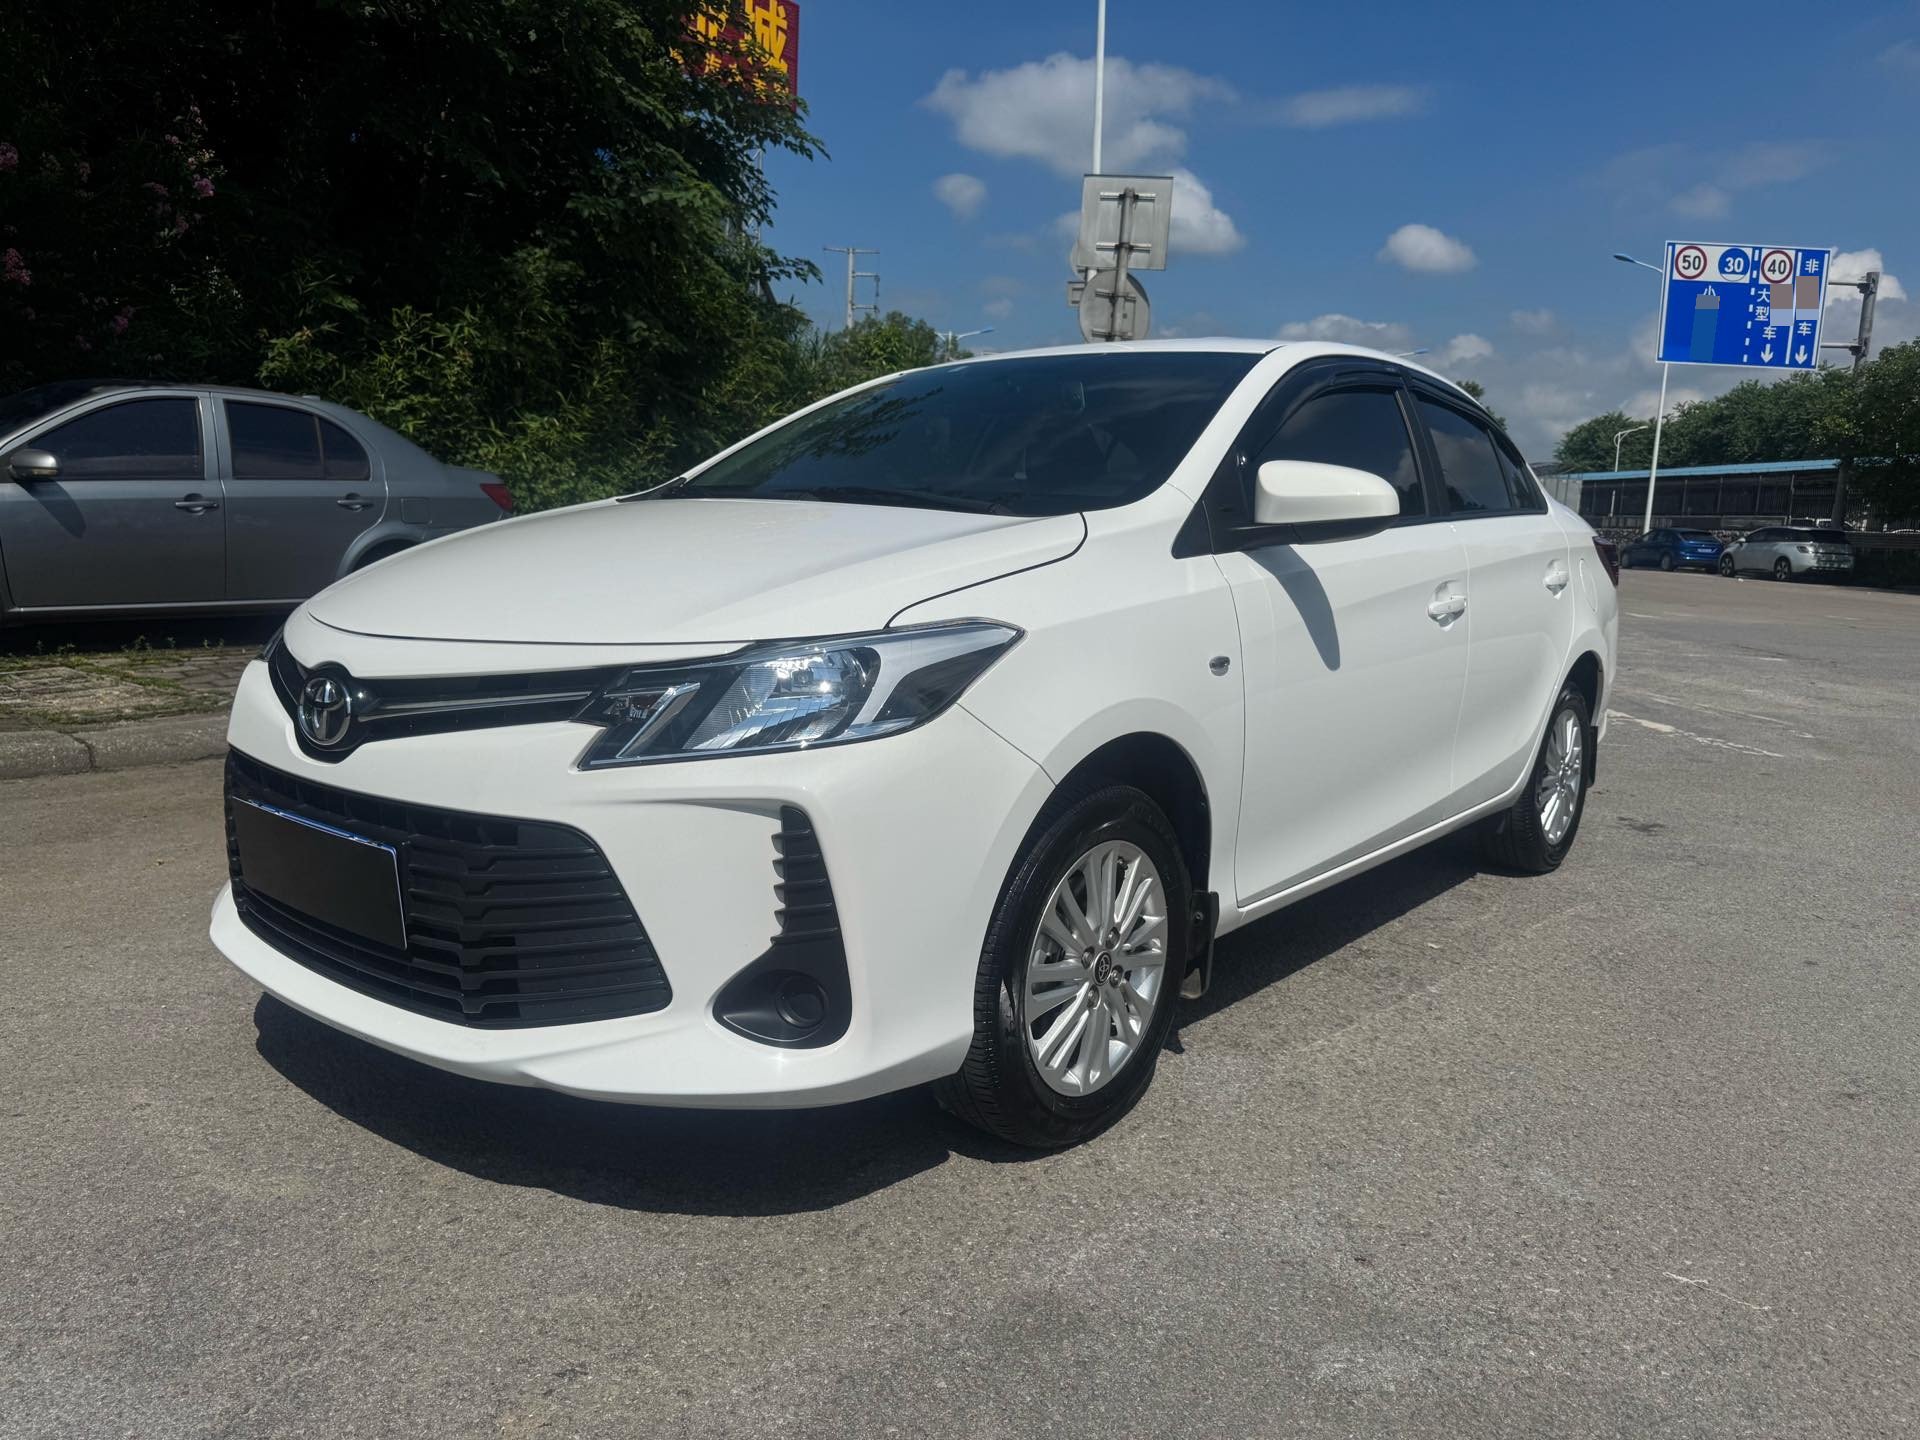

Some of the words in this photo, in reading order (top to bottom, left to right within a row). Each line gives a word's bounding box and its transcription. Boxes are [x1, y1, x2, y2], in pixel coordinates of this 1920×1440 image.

[1682, 255, 1702, 271] 50
[1724, 257, 1744, 273] 30
[1767, 260, 1787, 275] 40
